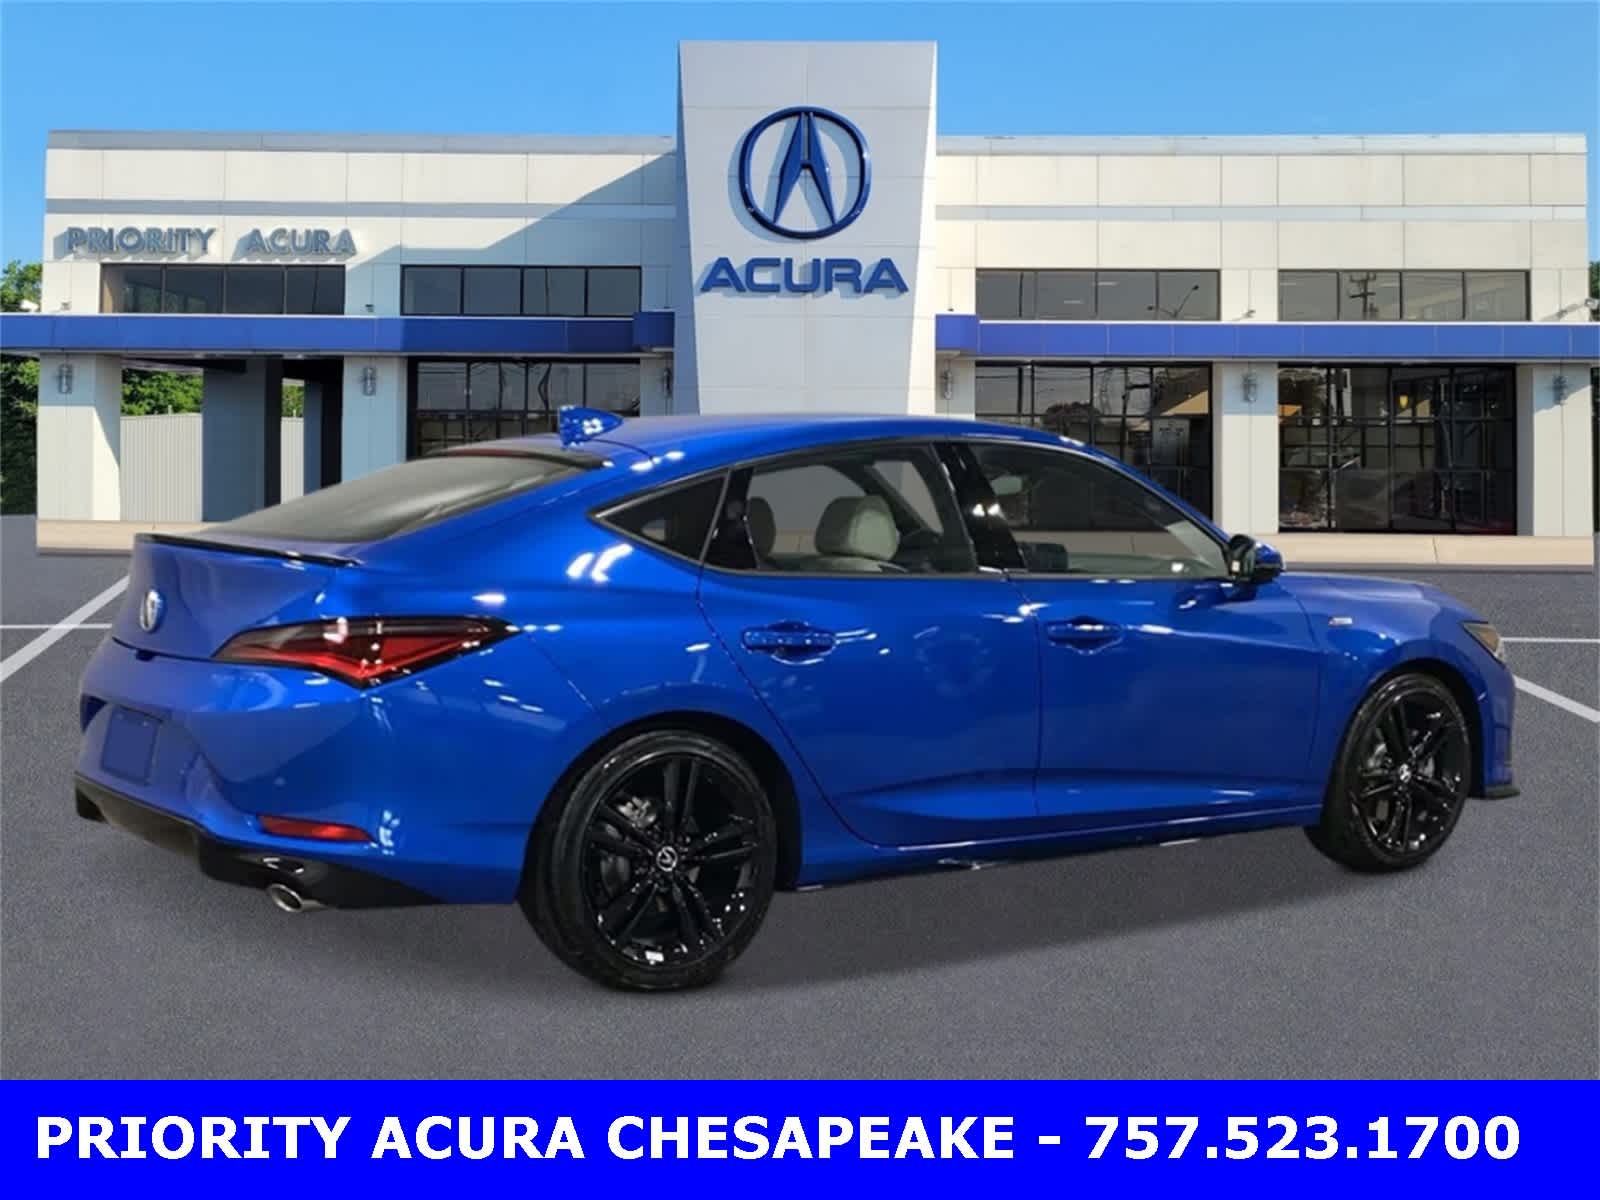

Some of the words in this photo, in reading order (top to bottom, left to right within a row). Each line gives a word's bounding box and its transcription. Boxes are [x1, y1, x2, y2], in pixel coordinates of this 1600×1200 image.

[66, 226, 217, 255] PRIORITY
[247, 228, 357, 256] ACURA
[700, 257, 909, 294] ACURA
